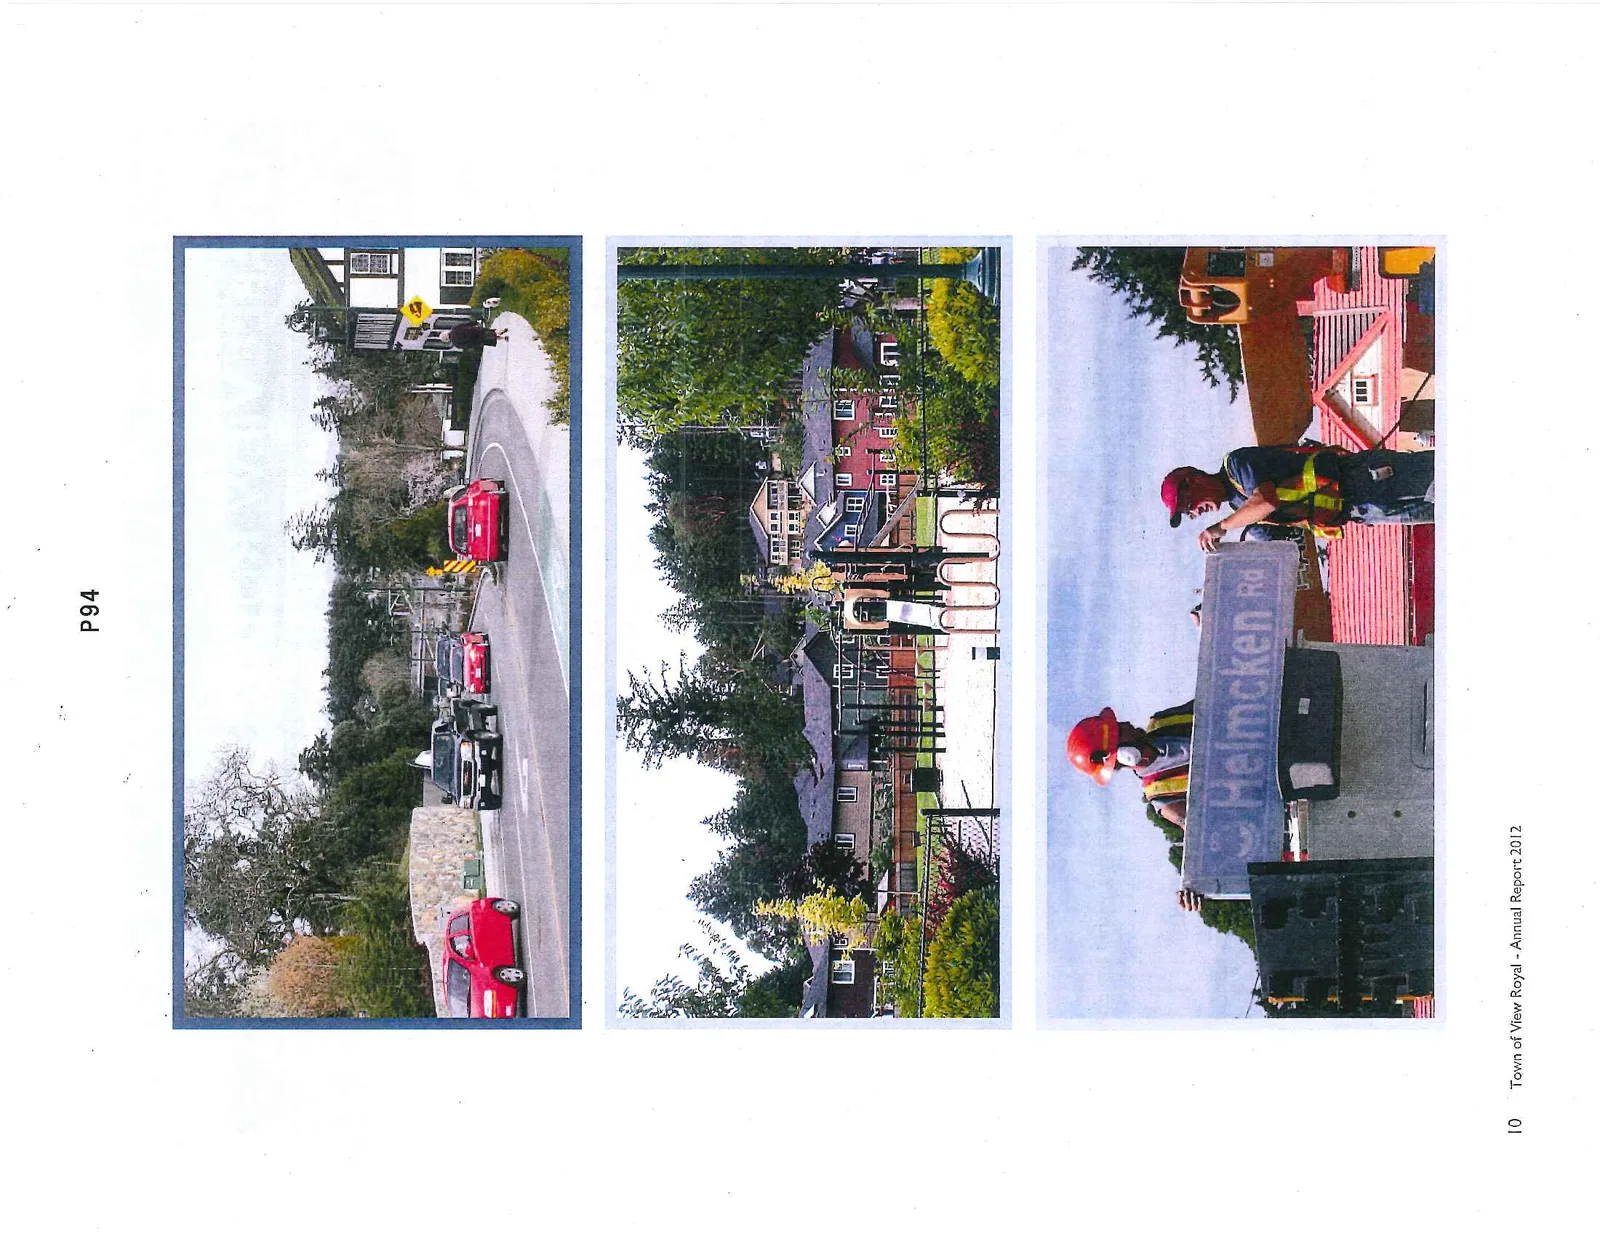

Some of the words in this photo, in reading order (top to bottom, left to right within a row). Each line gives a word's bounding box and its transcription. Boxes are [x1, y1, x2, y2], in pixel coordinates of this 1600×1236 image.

[1235, 568, 1265, 598] Rd
[79, 588, 100, 632] P94
[1209, 610, 1274, 808] Helmcken
[1509, 825, 1522, 856] 2012
[1509, 858, 1526, 903] Report
[1509, 907, 1522, 951] Annual
[1509, 964, 1526, 998] Royal
[1509, 1002, 1522, 1034] View
[1509, 1036, 1523, 1050] of
[1509, 1053, 1523, 1090] Town
[1507, 1118, 1523, 1134] 10
